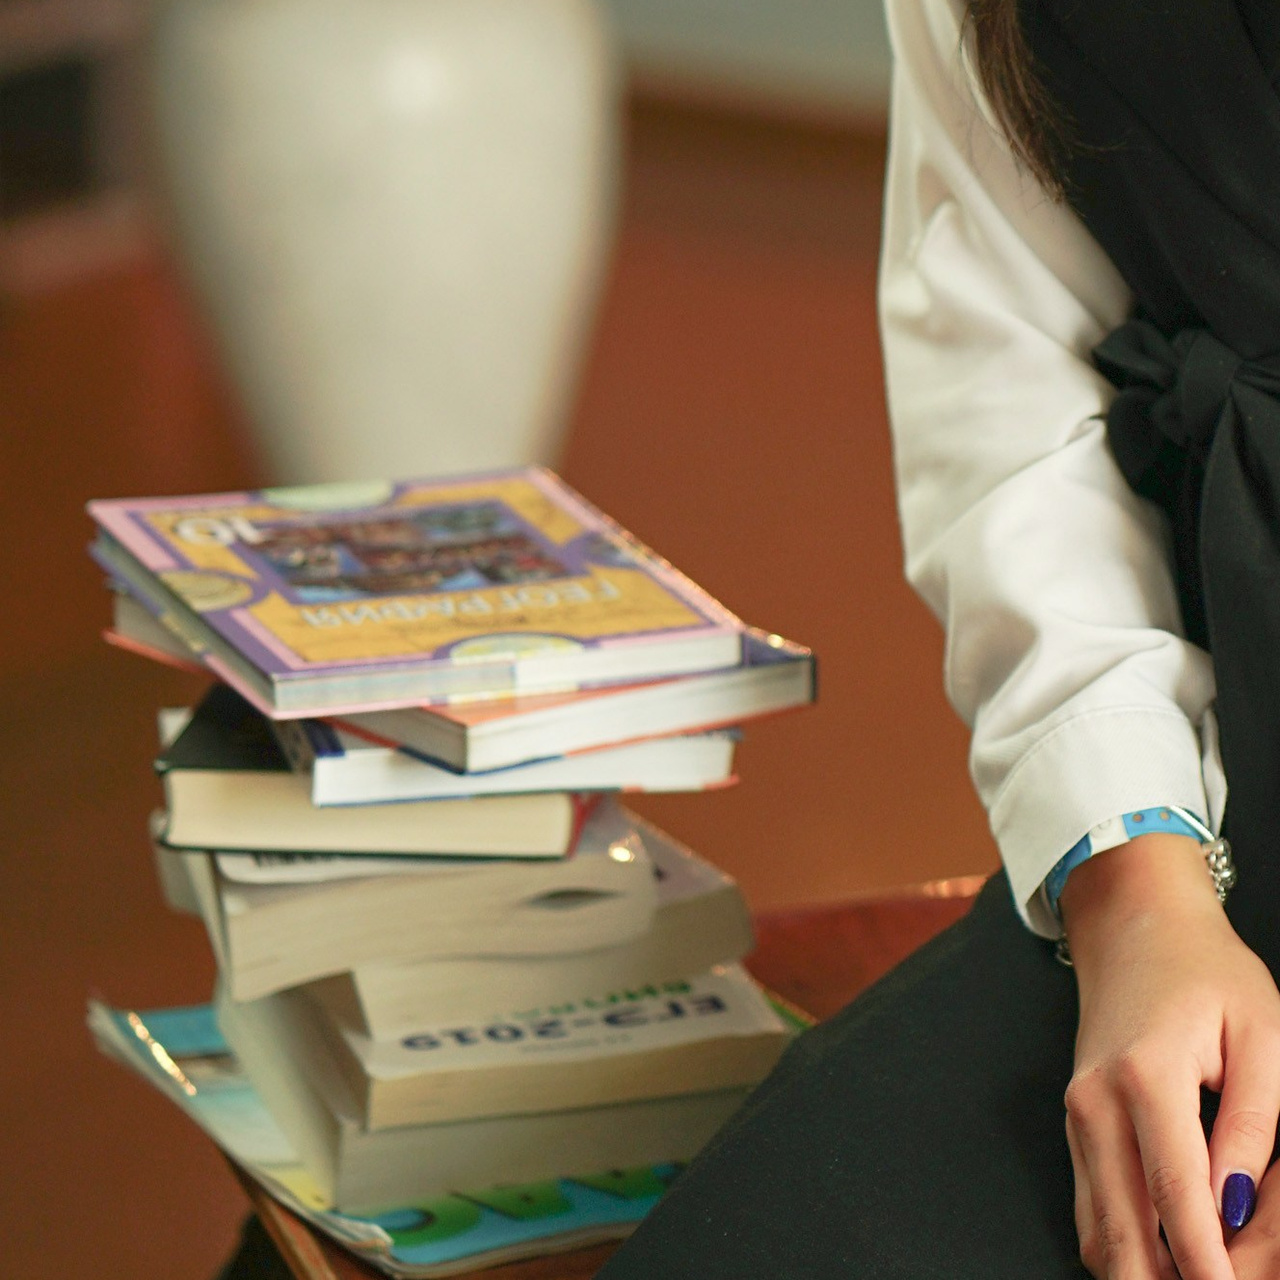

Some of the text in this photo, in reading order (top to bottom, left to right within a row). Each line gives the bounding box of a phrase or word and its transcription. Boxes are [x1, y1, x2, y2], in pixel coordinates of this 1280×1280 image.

[174, 516, 264, 546] 10
[301, 579, 621, 629] ГЕОГРАФИЯ
[401, 993, 729, 1051] ЕГЭ-2019
